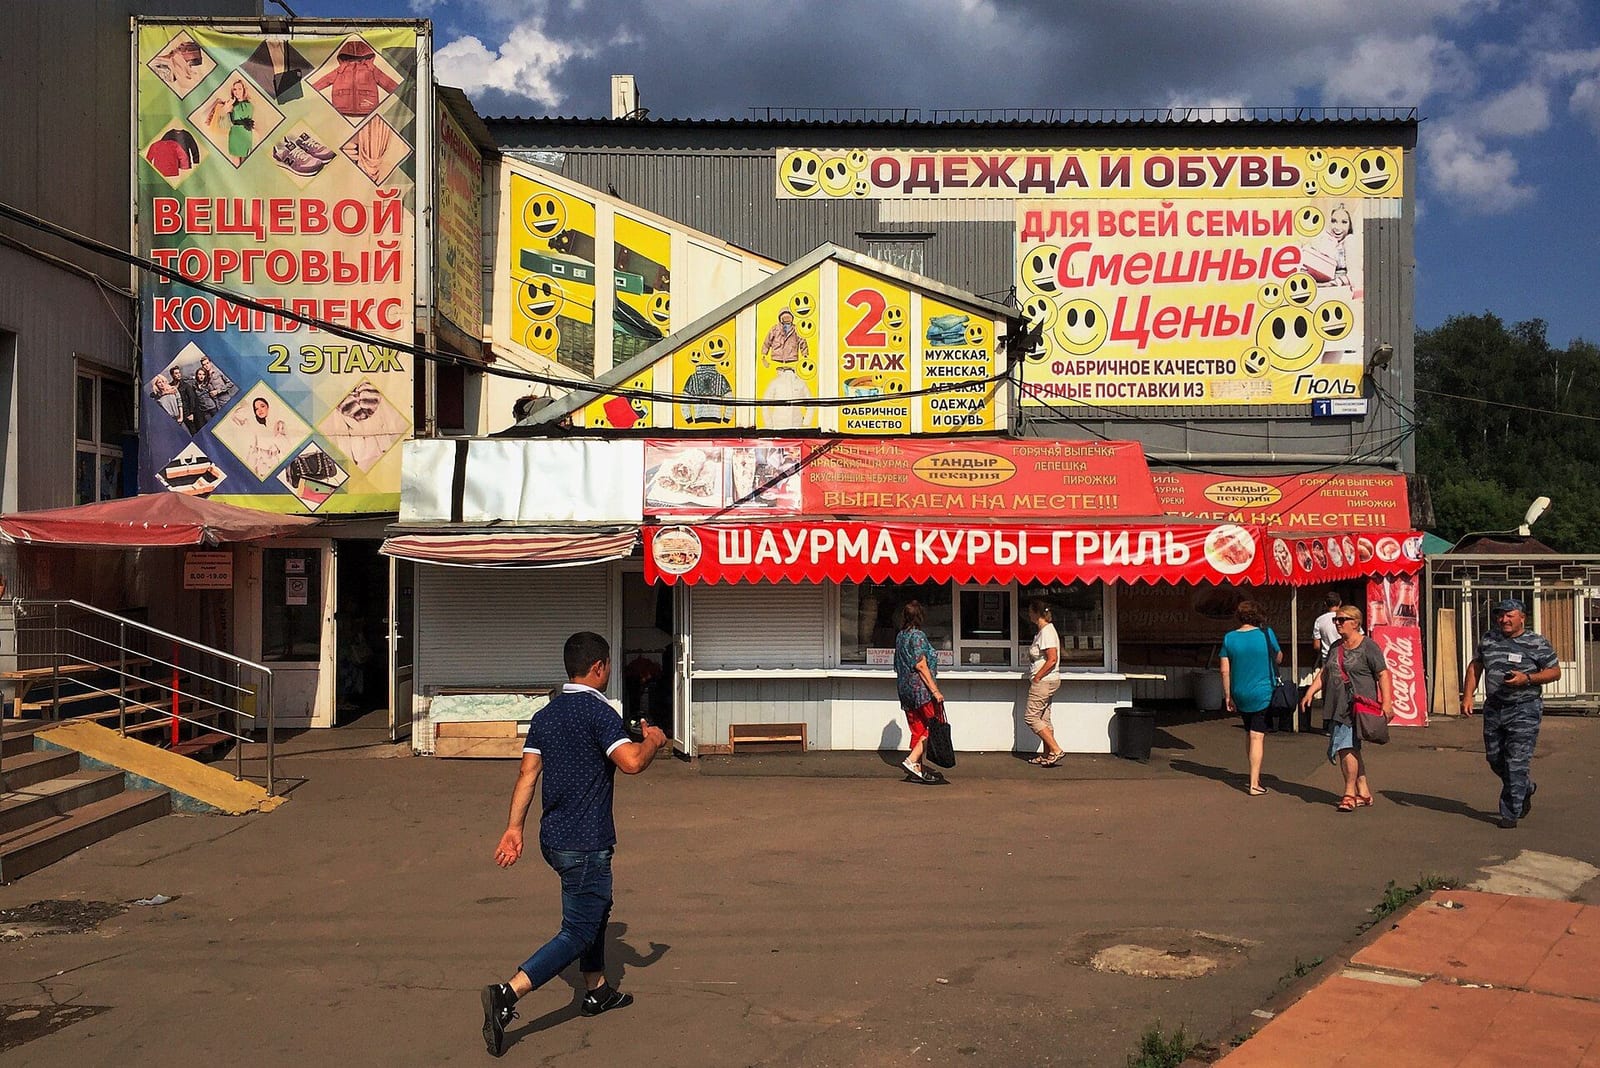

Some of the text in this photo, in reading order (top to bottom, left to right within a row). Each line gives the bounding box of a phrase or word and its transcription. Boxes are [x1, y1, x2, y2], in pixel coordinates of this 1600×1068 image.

[870, 156, 1301, 193] ОДЕЖДА И ОБУВЬ
[153, 189, 403, 241] ВЕЩЕВОЙ
[1021, 202, 1292, 242] ДЛЯ ВСЕЙ СЕМЬИ
[151, 240, 402, 285] ТОРГОВЫЙ
[1057, 241, 1300, 287] Смешные
[153, 297, 403, 333] КОМПЛЕКС
[845, 289, 886, 347] 2
[1110, 296, 1254, 349] Цены
[267, 344, 404, 374] 2 ЭТАЖ
[843, 354, 905, 370] ЭТАЖ
[926, 350, 990, 361] МУЖСКАЯ,
[926, 366, 990, 378] ЖЕНСКАЯ,
[1051, 360, 1236, 375] ФАБРИЧНОЕ КАЧЕСТВО
[1022, 383, 1092, 398] ПРЯМЫЕ
[1095, 383, 1180, 398] ПОСТАВКИ
[1184, 383, 1204, 397] ИЗ
[1294, 375, 1356, 394] Гюль
[931, 399, 985, 410] ОДЕЖДА
[1320, 404, 1327, 414] 1
[842, 407, 907, 417] ФАБРИЧНОЕ
[848, 420, 902, 428] КАЧЕСТВО
[933, 415, 983, 426] И ОБУВЬ
[1013, 447, 1115, 456] ГОРЯЧАЯ ВЫПЕЧКА
[930, 459, 998, 468] ТАНДЫР
[1034, 461, 1087, 471] ЛЕПЕШКА
[1063, 475, 1117, 485] ПИРОЖКИ
[1300, 479, 1394, 487] ГОРЯЧАЯ ВЫПЕЧКА
[1217, 485, 1268, 494] ТАНДЫР
[1320, 489, 1369, 497] ЛЕПЕШКА
[824, 491, 1119, 510] ВЫПЕКАЕМ НА МЕСТЕ!!!
[1347, 500, 1396, 508] ПИРОЖКИ
[1250, 513, 1282, 526] НА
[1289, 513, 1387, 526] МЕСТЕ!!!
[718, 529, 1191, 566] ШАУРМА КУРЫ-ГРИЛЬ
[1384, 634, 1418, 720] Coca-Cola
